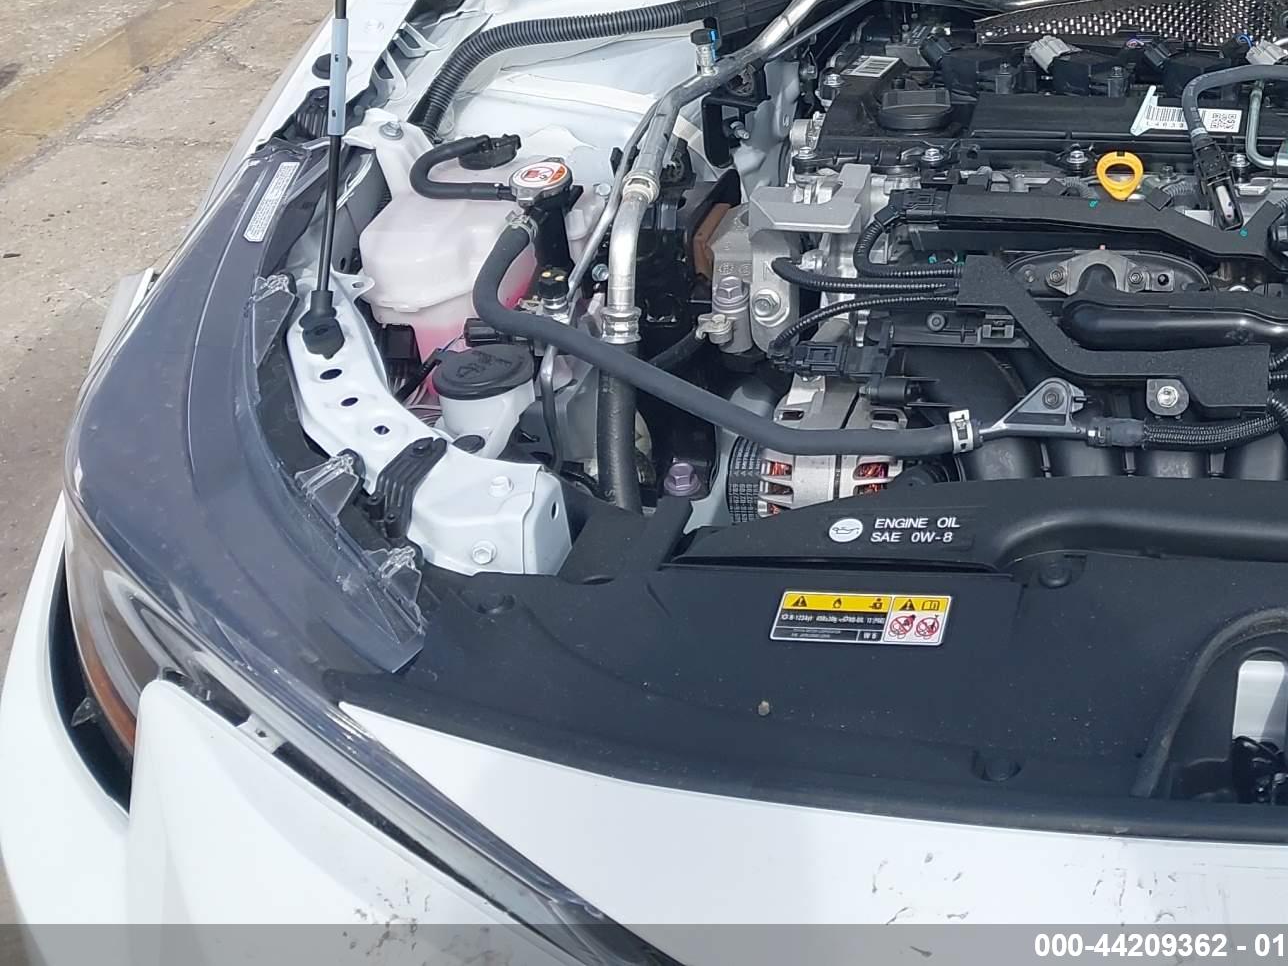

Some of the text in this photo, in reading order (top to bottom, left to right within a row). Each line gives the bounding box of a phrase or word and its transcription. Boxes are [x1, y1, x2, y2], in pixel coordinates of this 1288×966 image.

[874, 516, 961, 529] ENGINE OIL
[870, 531, 953, 543] SAE 0W-8
